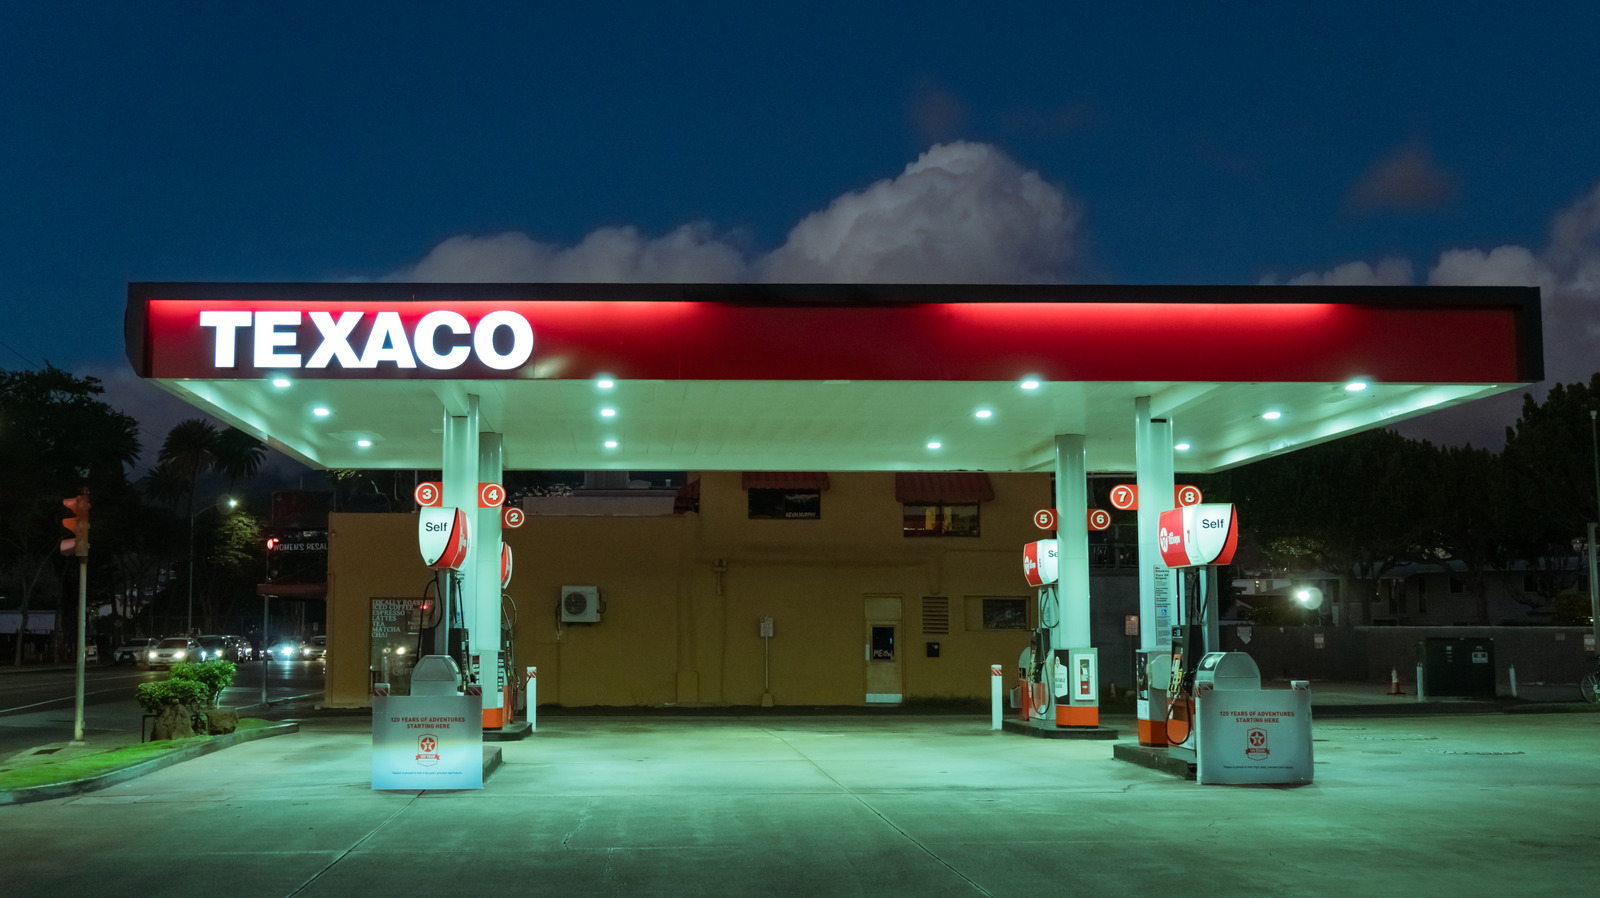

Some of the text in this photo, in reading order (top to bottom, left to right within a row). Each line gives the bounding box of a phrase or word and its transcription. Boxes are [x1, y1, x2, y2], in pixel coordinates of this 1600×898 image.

[200, 310, 534, 370] TEXACO
[422, 488, 432, 500] 3
[488, 489, 499, 501] 4
[1117, 491, 1127, 503] 7
[1184, 491, 1195, 503] 8
[510, 512, 519, 522] 2
[1039, 514, 1048, 524] 5
[1096, 514, 1105, 524] 6
[425, 522, 448, 532] Self
[1202, 519, 1224, 529] Self
[273, 543, 305, 551] WOMEN'S
[873, 649, 893, 659] MEOW
